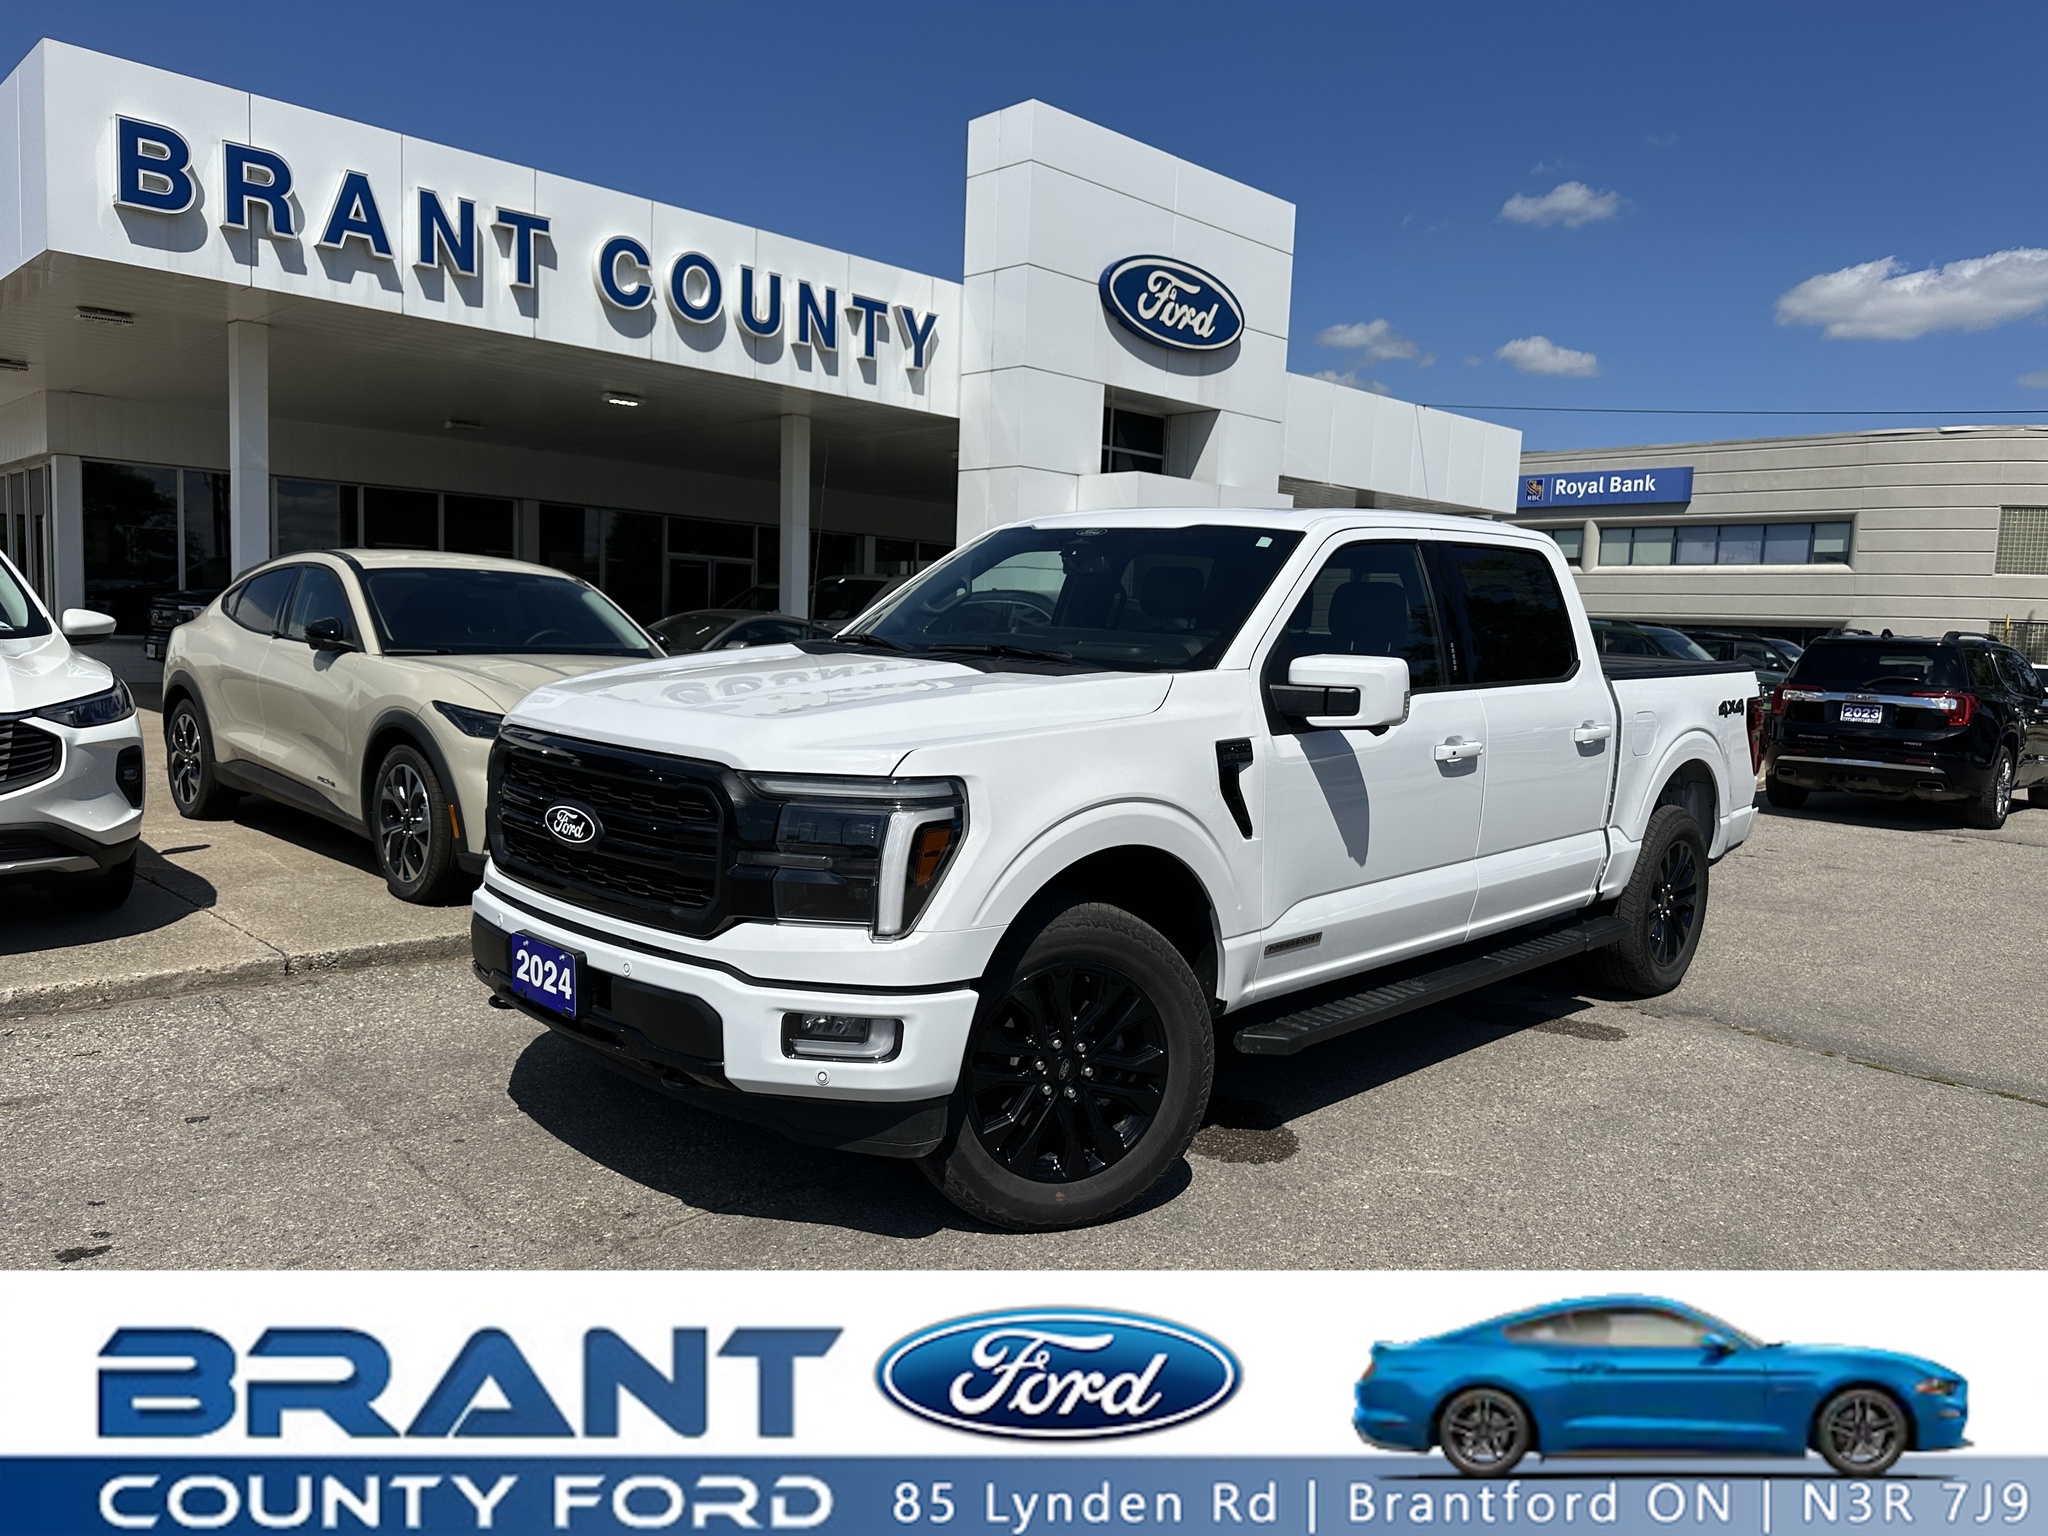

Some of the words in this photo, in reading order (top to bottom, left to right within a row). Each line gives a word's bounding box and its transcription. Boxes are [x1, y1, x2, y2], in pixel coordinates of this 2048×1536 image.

[113, 114, 551, 288] BRANT
[593, 234, 939, 370] COUNTY
[1138, 270, 1219, 338] Ford
[1555, 476, 1604, 498] Royal
[1610, 474, 1656, 493] Bank
[1844, 707, 1879, 719] 2023
[553, 809, 585, 838] Ford
[516, 949, 572, 1000] 2024
